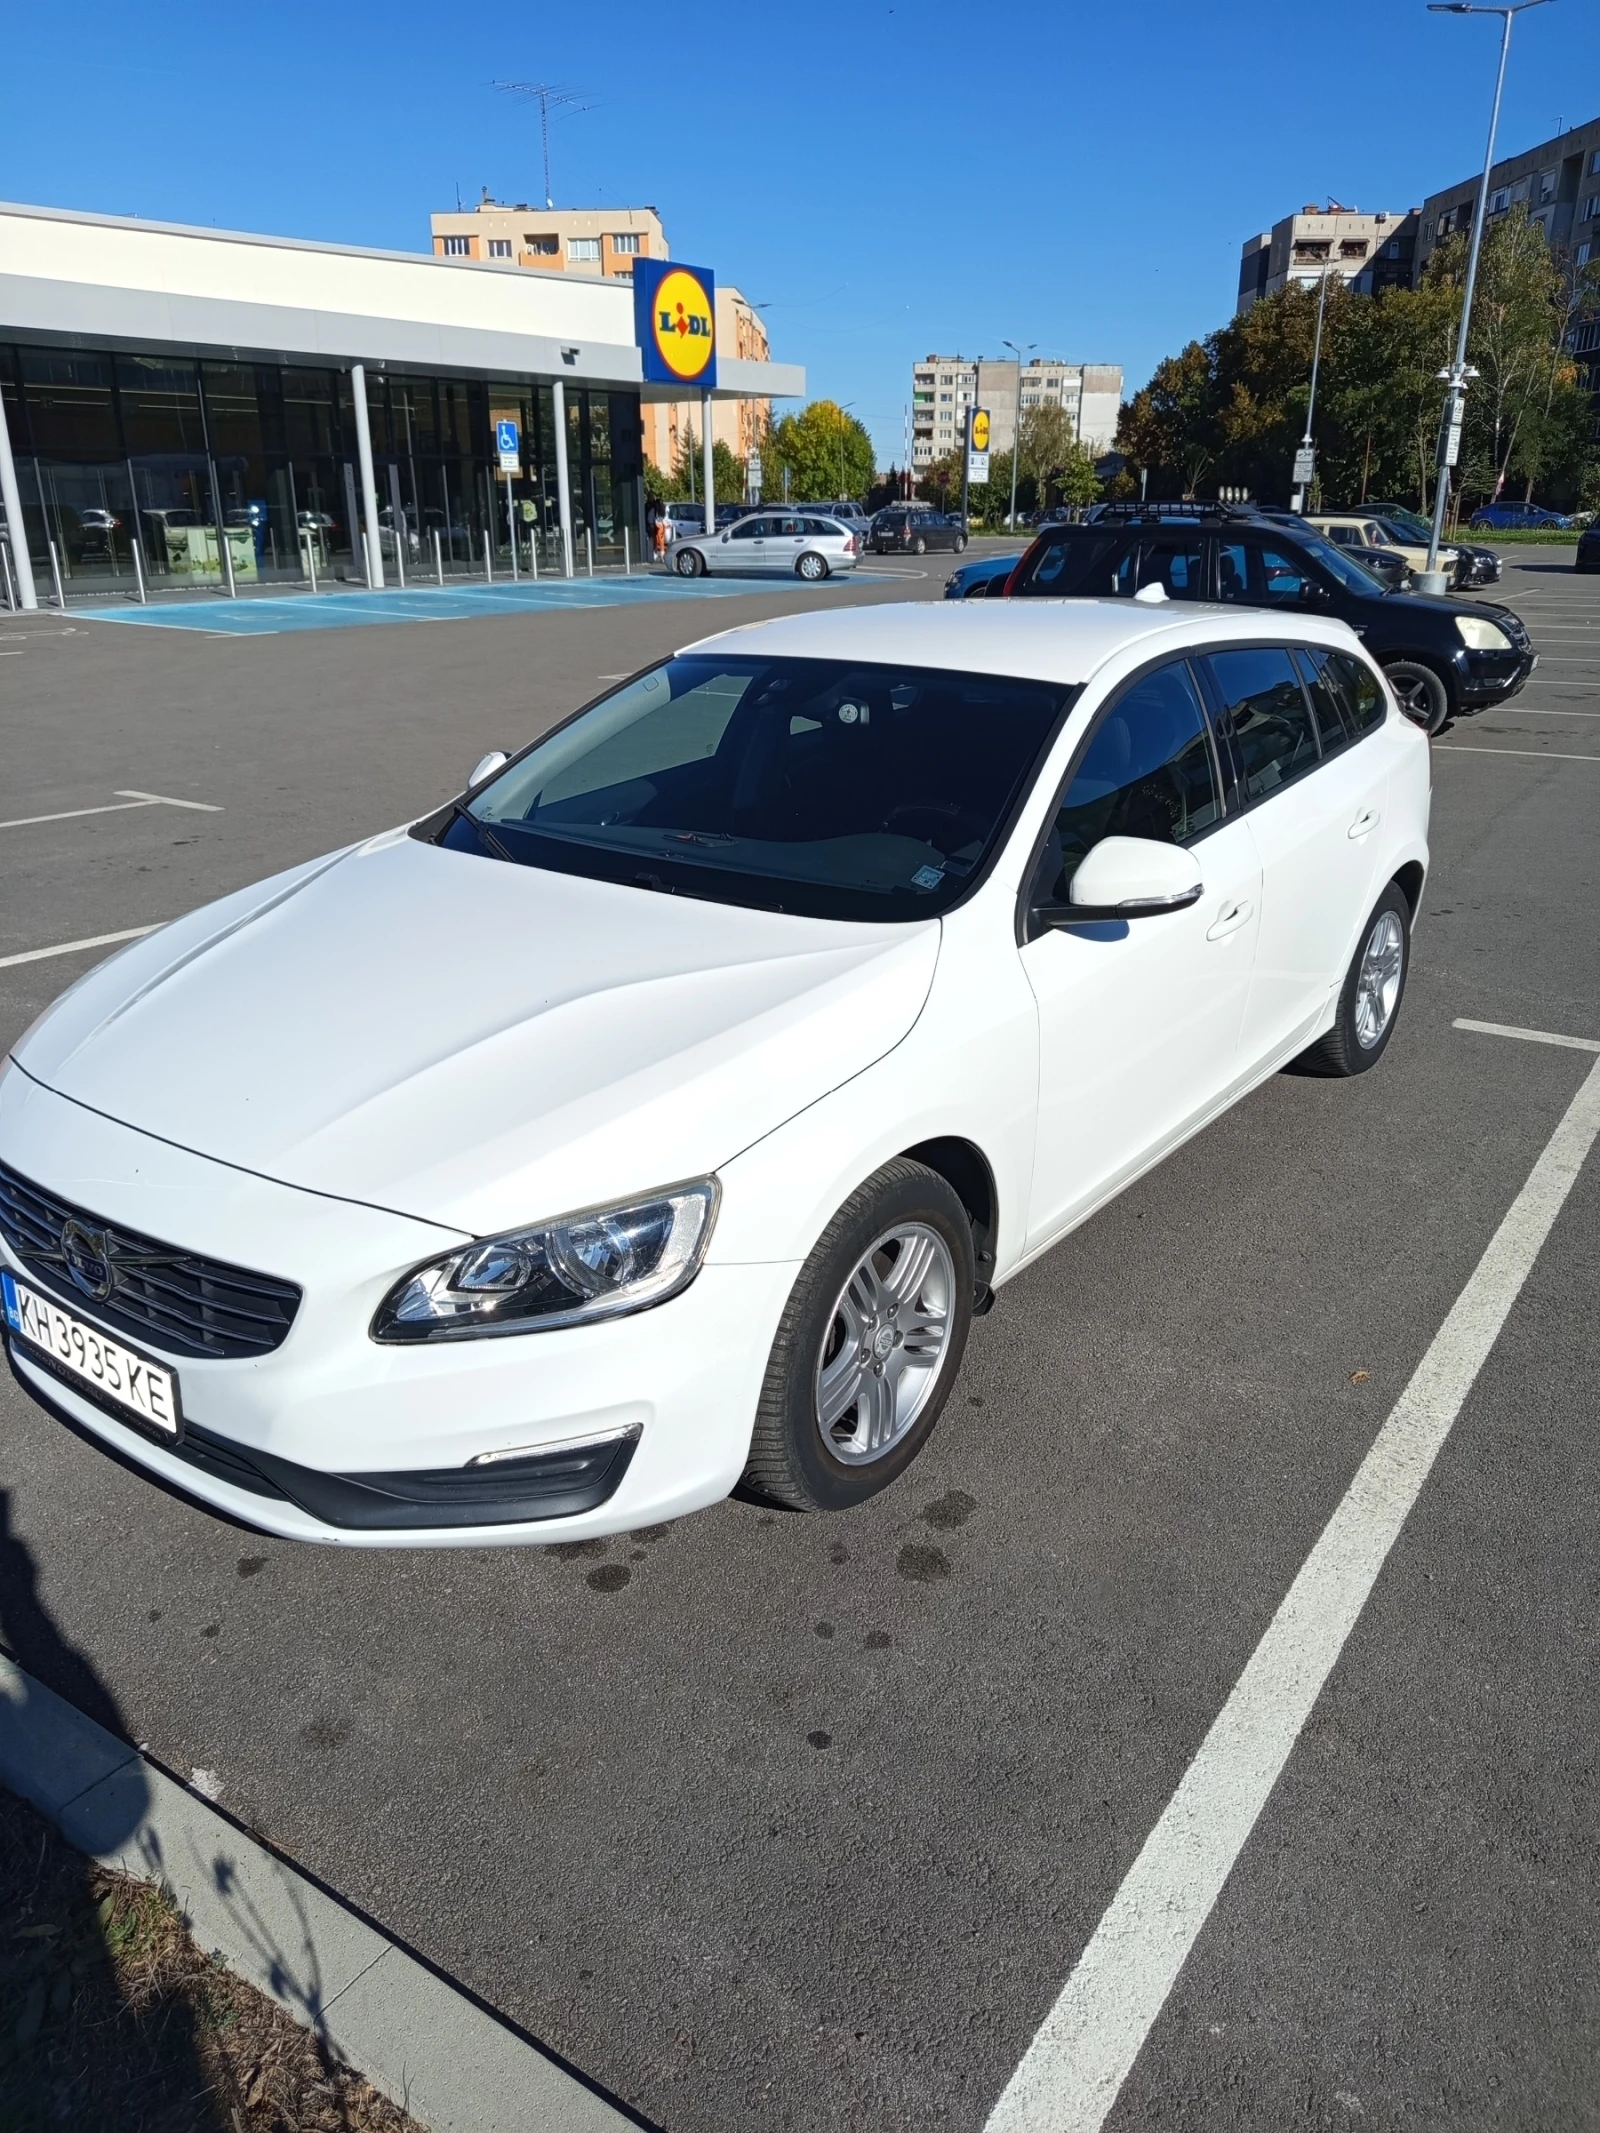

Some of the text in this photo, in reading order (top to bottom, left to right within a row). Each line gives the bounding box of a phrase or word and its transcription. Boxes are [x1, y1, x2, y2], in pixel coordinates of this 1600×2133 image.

[8, 1305, 20, 1323] BG
[18, 1287, 169, 1422] KH 3935 KE
